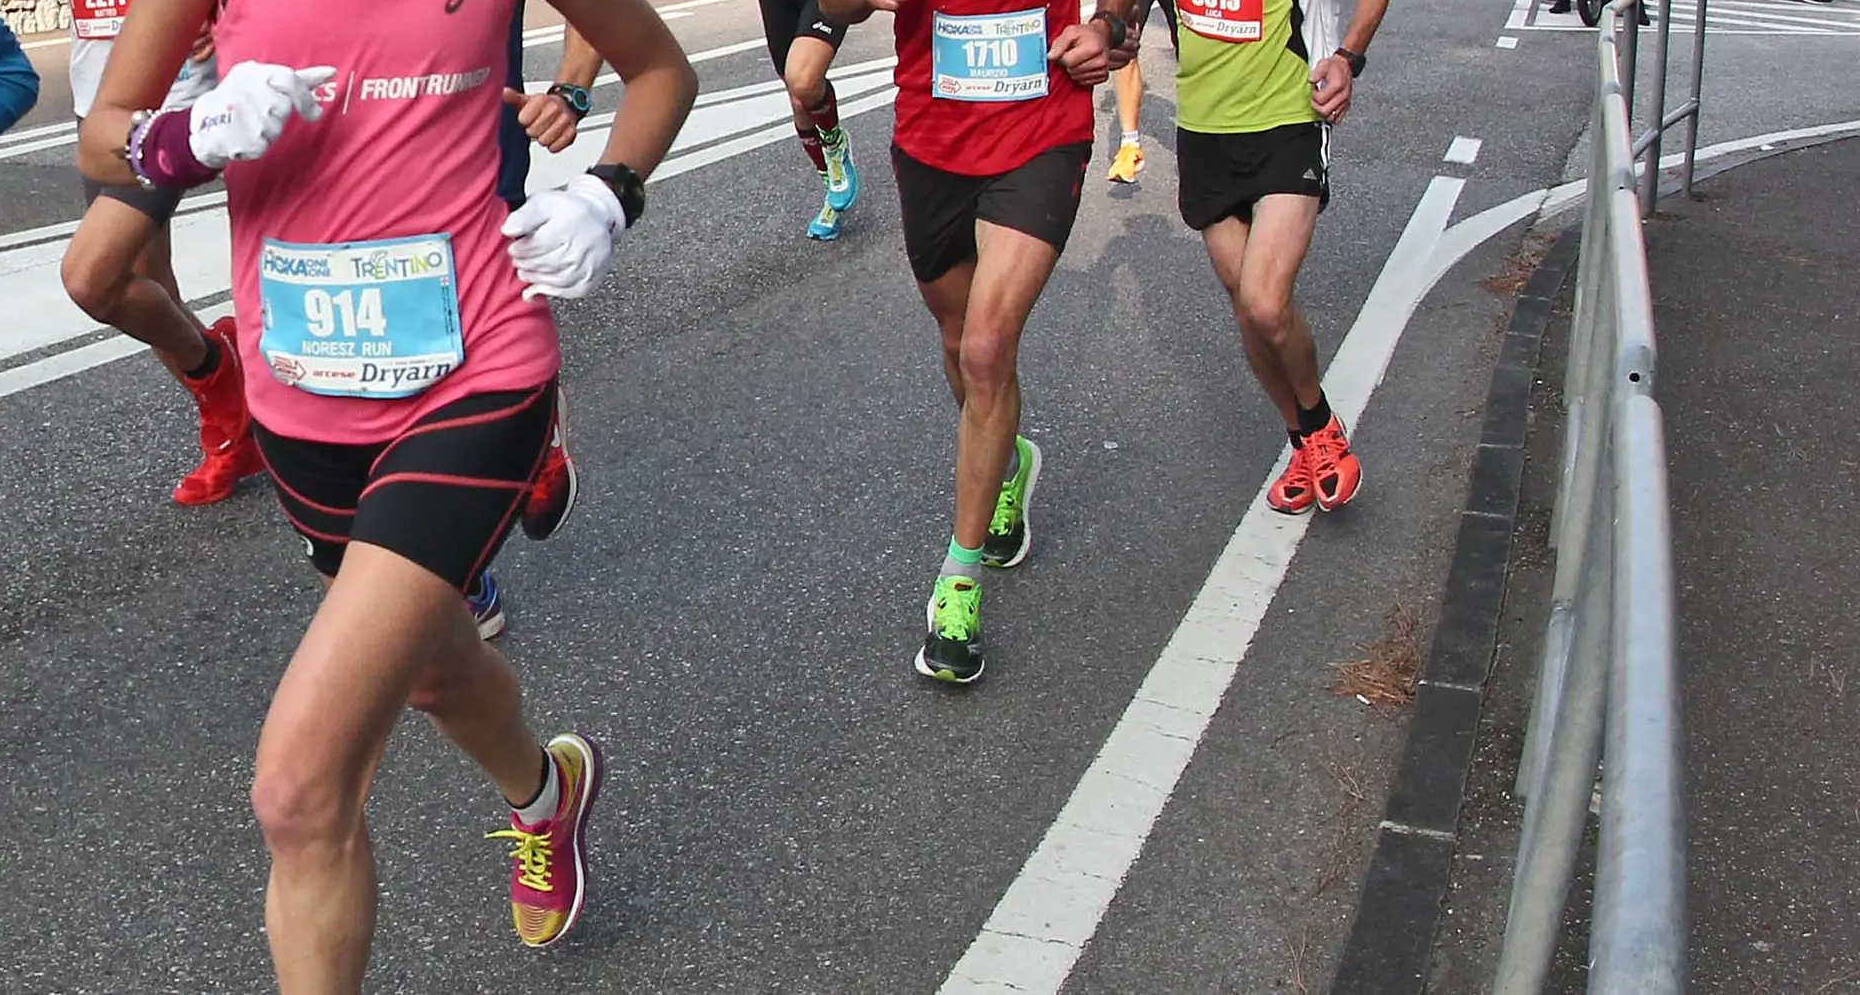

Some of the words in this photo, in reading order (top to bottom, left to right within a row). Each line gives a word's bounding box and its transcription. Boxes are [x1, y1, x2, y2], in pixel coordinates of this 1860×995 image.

[1216, 22, 1257, 35] Dryarn
[962, 38, 1018, 67] 1710
[360, 67, 491, 100] FRONTRUNNER
[994, 79, 1042, 95] Dryarn
[264, 253, 307, 277] HOKA
[351, 252, 443, 280] TRENTINO
[304, 287, 387, 338] 914
[302, 340, 356, 356] NORESZ
[362, 341, 392, 356] RUN
[359, 362, 451, 389] Dryarn
